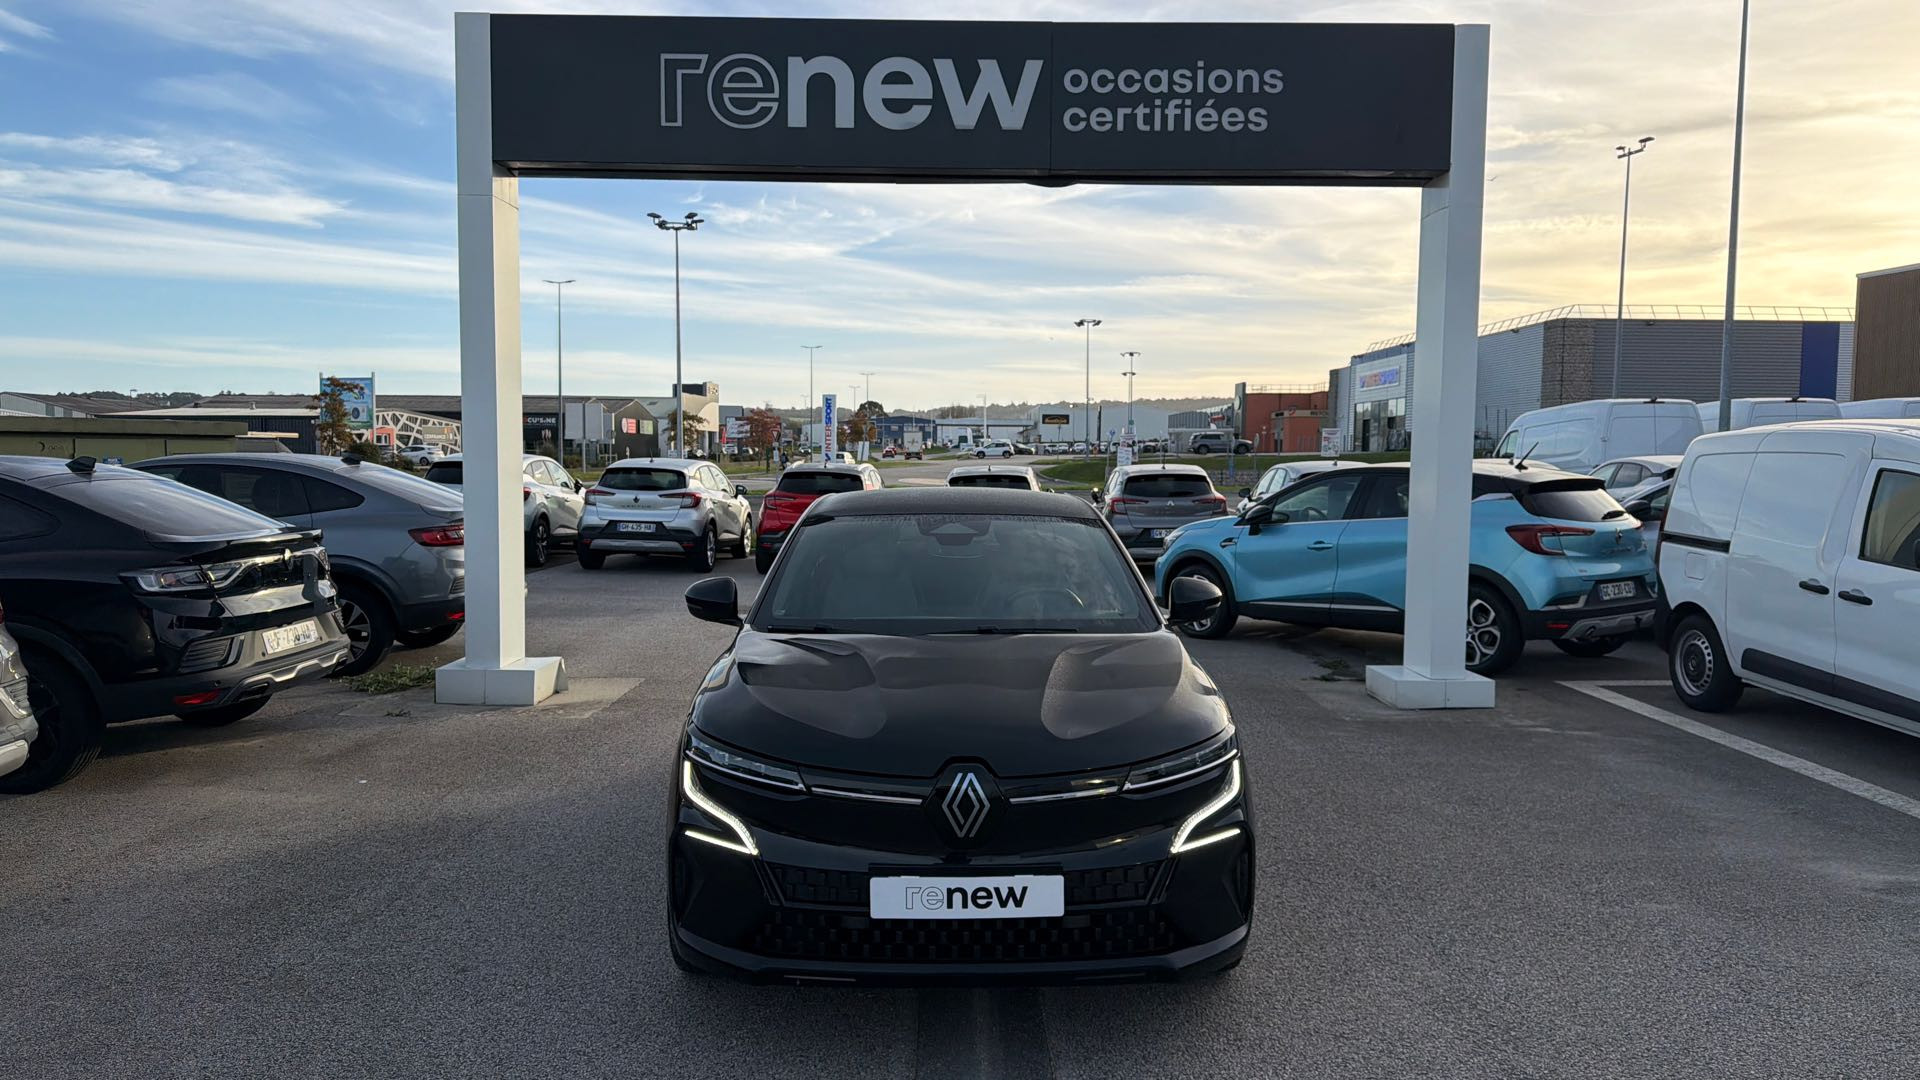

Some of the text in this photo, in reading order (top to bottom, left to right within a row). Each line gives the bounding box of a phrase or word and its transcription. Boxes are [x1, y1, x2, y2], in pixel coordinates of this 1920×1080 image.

[659, 52, 1044, 131] renew
[1062, 60, 1285, 95] occasions
[1062, 98, 1269, 133] certifiées
[824, 397, 832, 452] INTERSPORT
[904, 885, 1029, 910] renew
